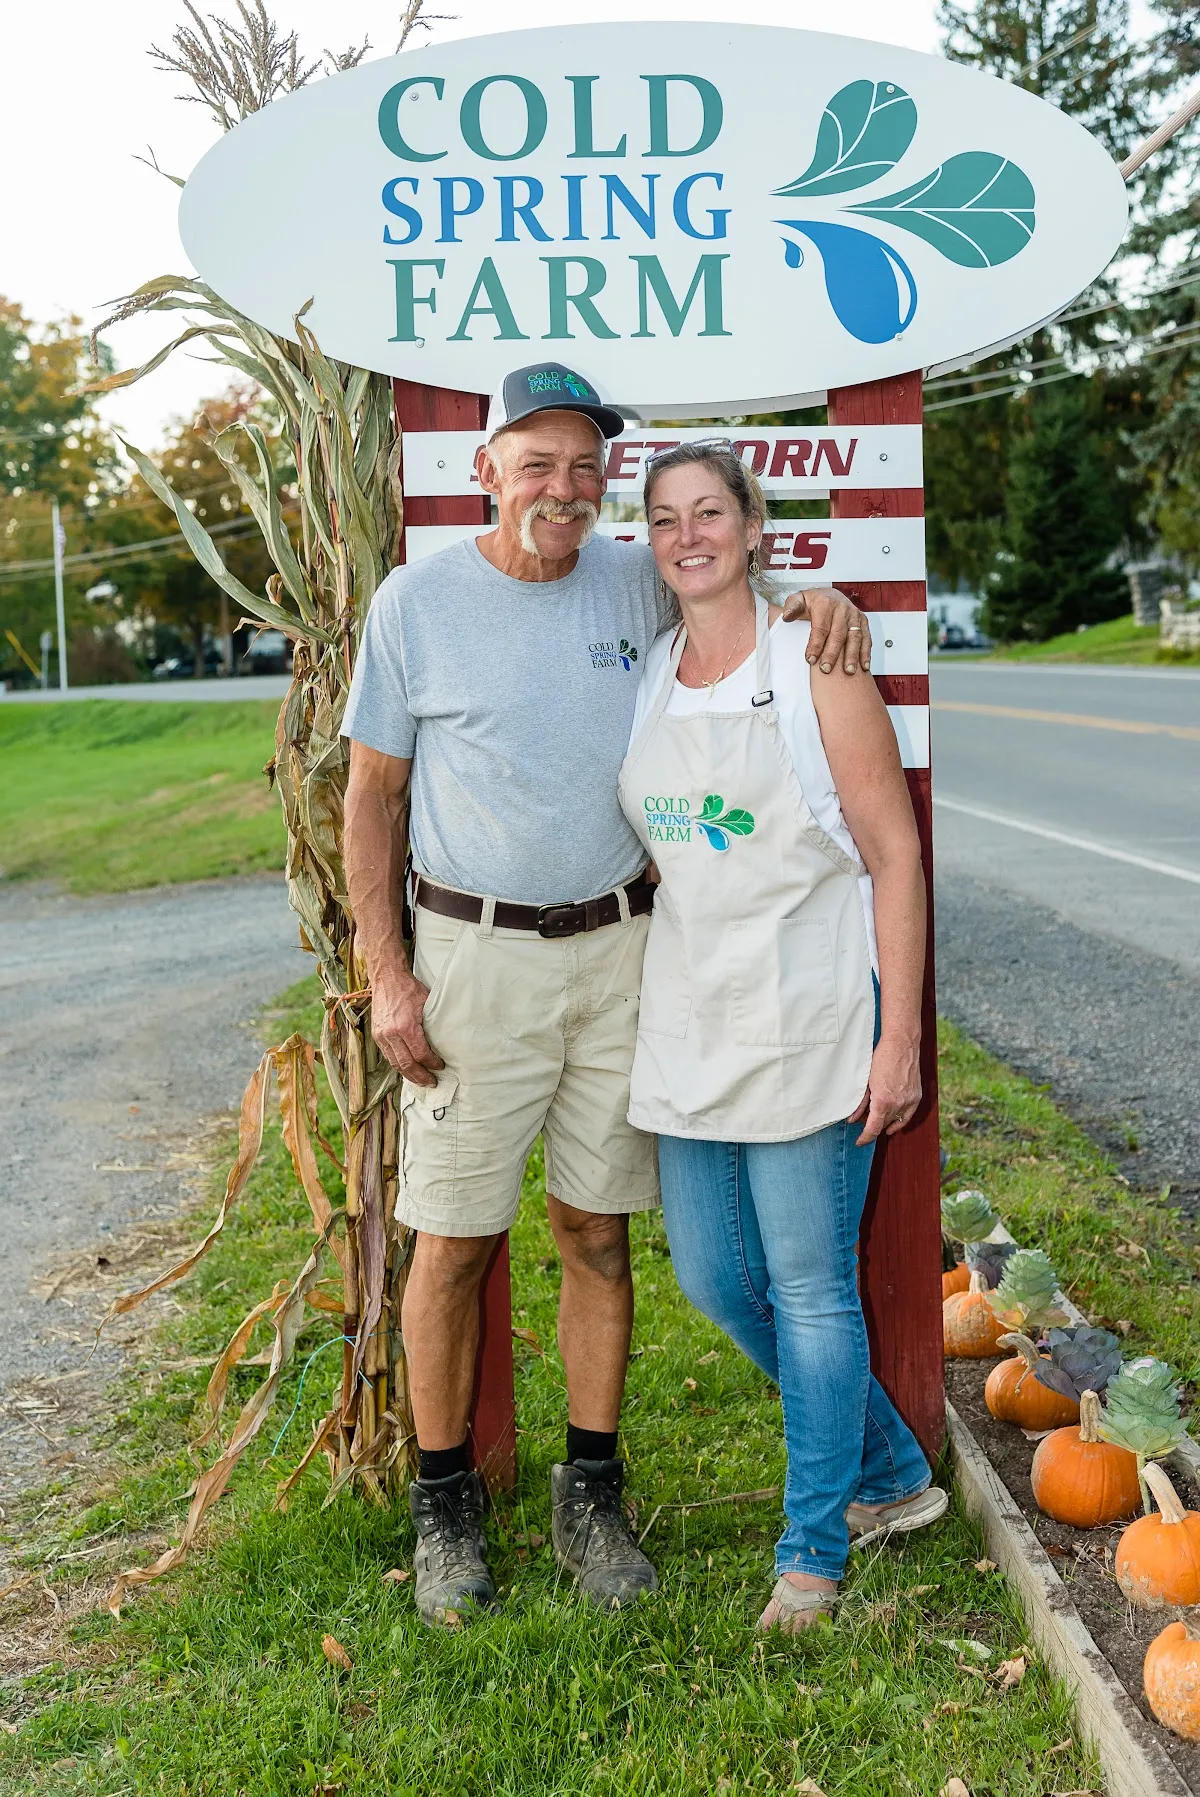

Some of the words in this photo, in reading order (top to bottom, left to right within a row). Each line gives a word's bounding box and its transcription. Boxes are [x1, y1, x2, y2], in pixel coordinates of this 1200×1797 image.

[378, 74, 723, 162] COLD
[381, 172, 732, 245] SPRING
[385, 254, 733, 343] FARM
[527, 371, 559, 382] COLD
[529, 379, 560, 387] SPRING
[530, 383, 561, 394] FARM
[732, 439, 859, 477] ORN
[588, 642, 614, 652] COLD
[591, 651, 617, 660] SPRING
[592, 659, 618, 669] FARM
[644, 796, 690, 814] COLD
[646, 813, 691, 826] SPRING
[647, 825, 692, 842] FARM
